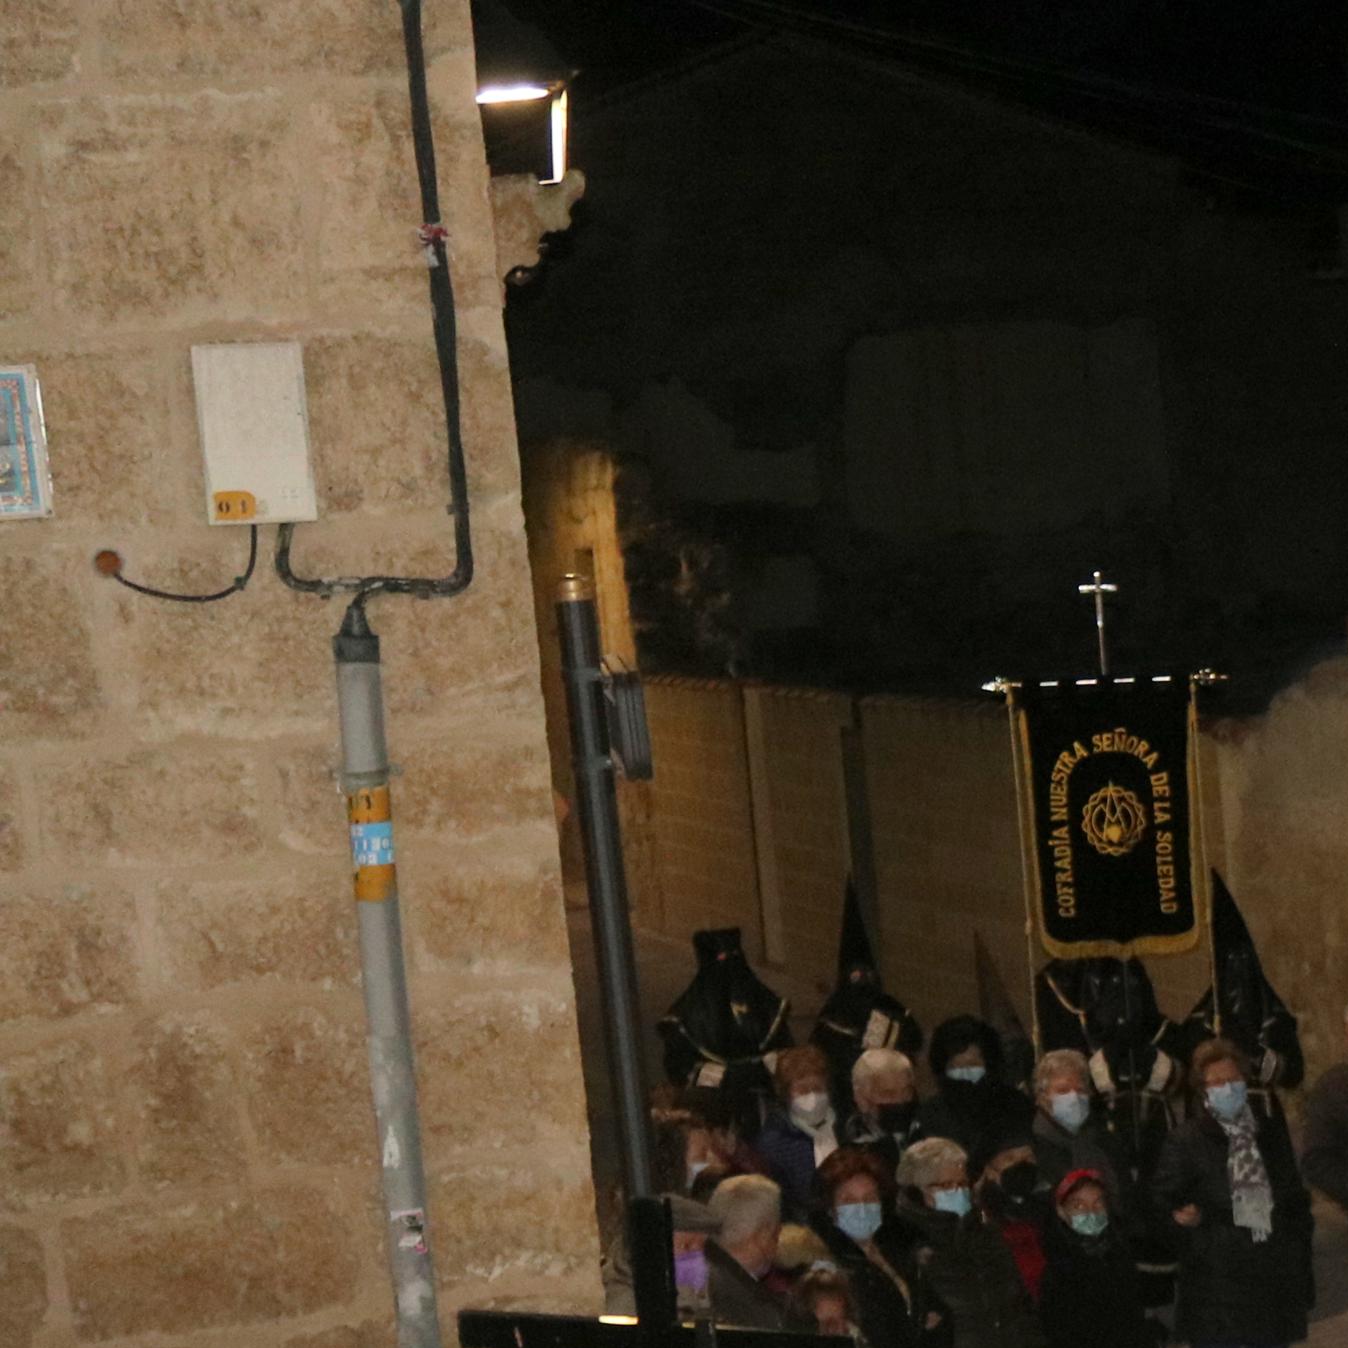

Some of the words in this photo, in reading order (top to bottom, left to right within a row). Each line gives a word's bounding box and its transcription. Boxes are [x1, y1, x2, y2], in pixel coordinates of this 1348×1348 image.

[1091, 727, 1159, 770] SEÑORA
[1050, 740, 1089, 822] NUESTRA
[1150, 771, 1171, 798] DE
[1153, 801, 1172, 824] LA
[1048, 825, 1076, 919] COFRADÍA
[1155, 830, 1178, 914] SOLEDAD
